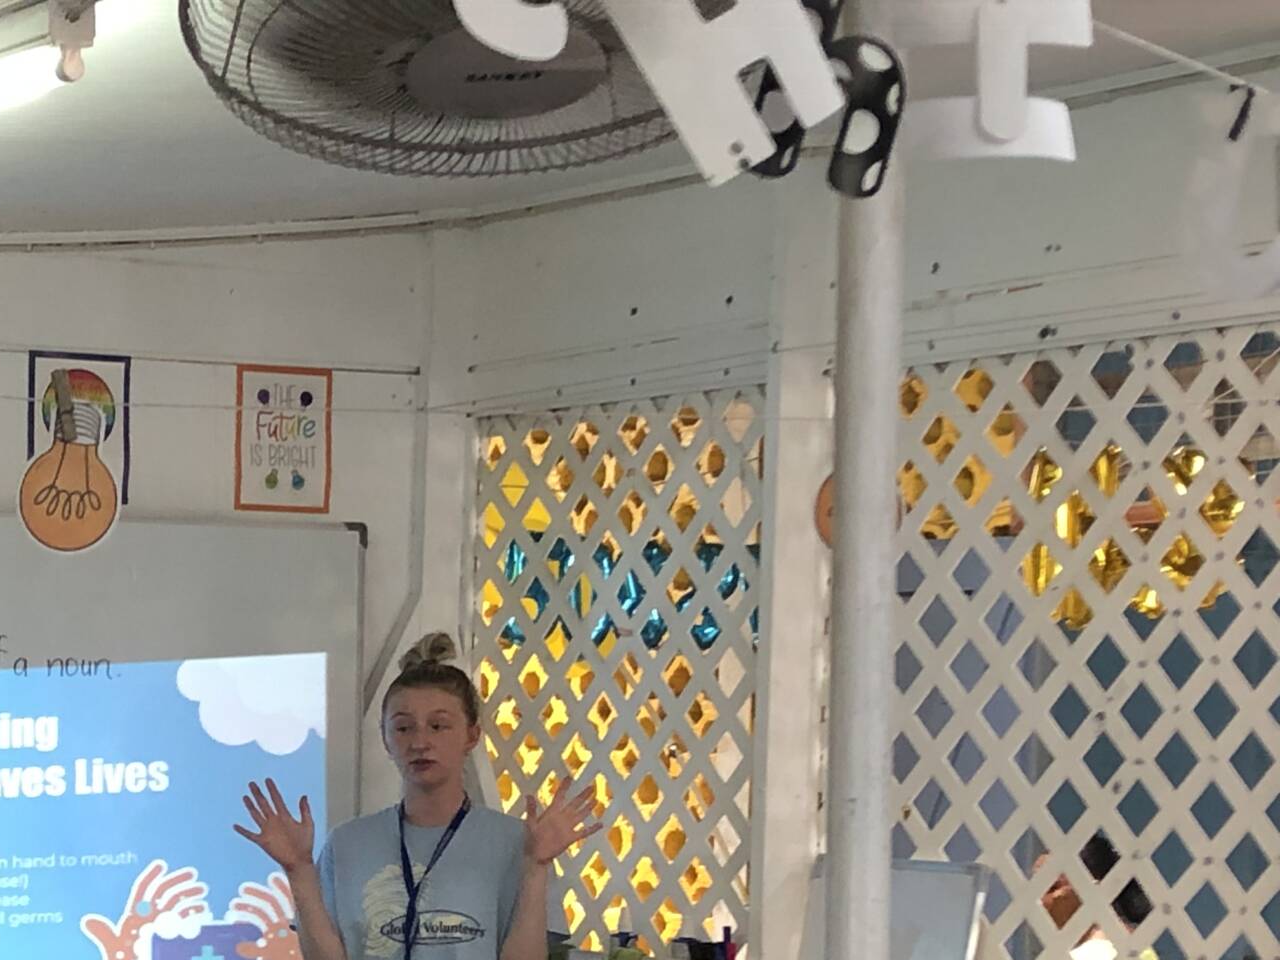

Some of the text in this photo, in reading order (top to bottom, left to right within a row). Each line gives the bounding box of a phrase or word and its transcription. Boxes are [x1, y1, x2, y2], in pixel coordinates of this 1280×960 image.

[271, 383, 296, 407] THE
[255, 411, 316, 442] Future
[249, 443, 318, 468] IS BRIGHT
[13, 655, 28, 677] a
[74, 757, 170, 797] Lives
[12, 853, 56, 869] hand
[59, 855, 78, 867] to
[81, 851, 138, 866] mouth
[8, 912, 64, 928] germs
